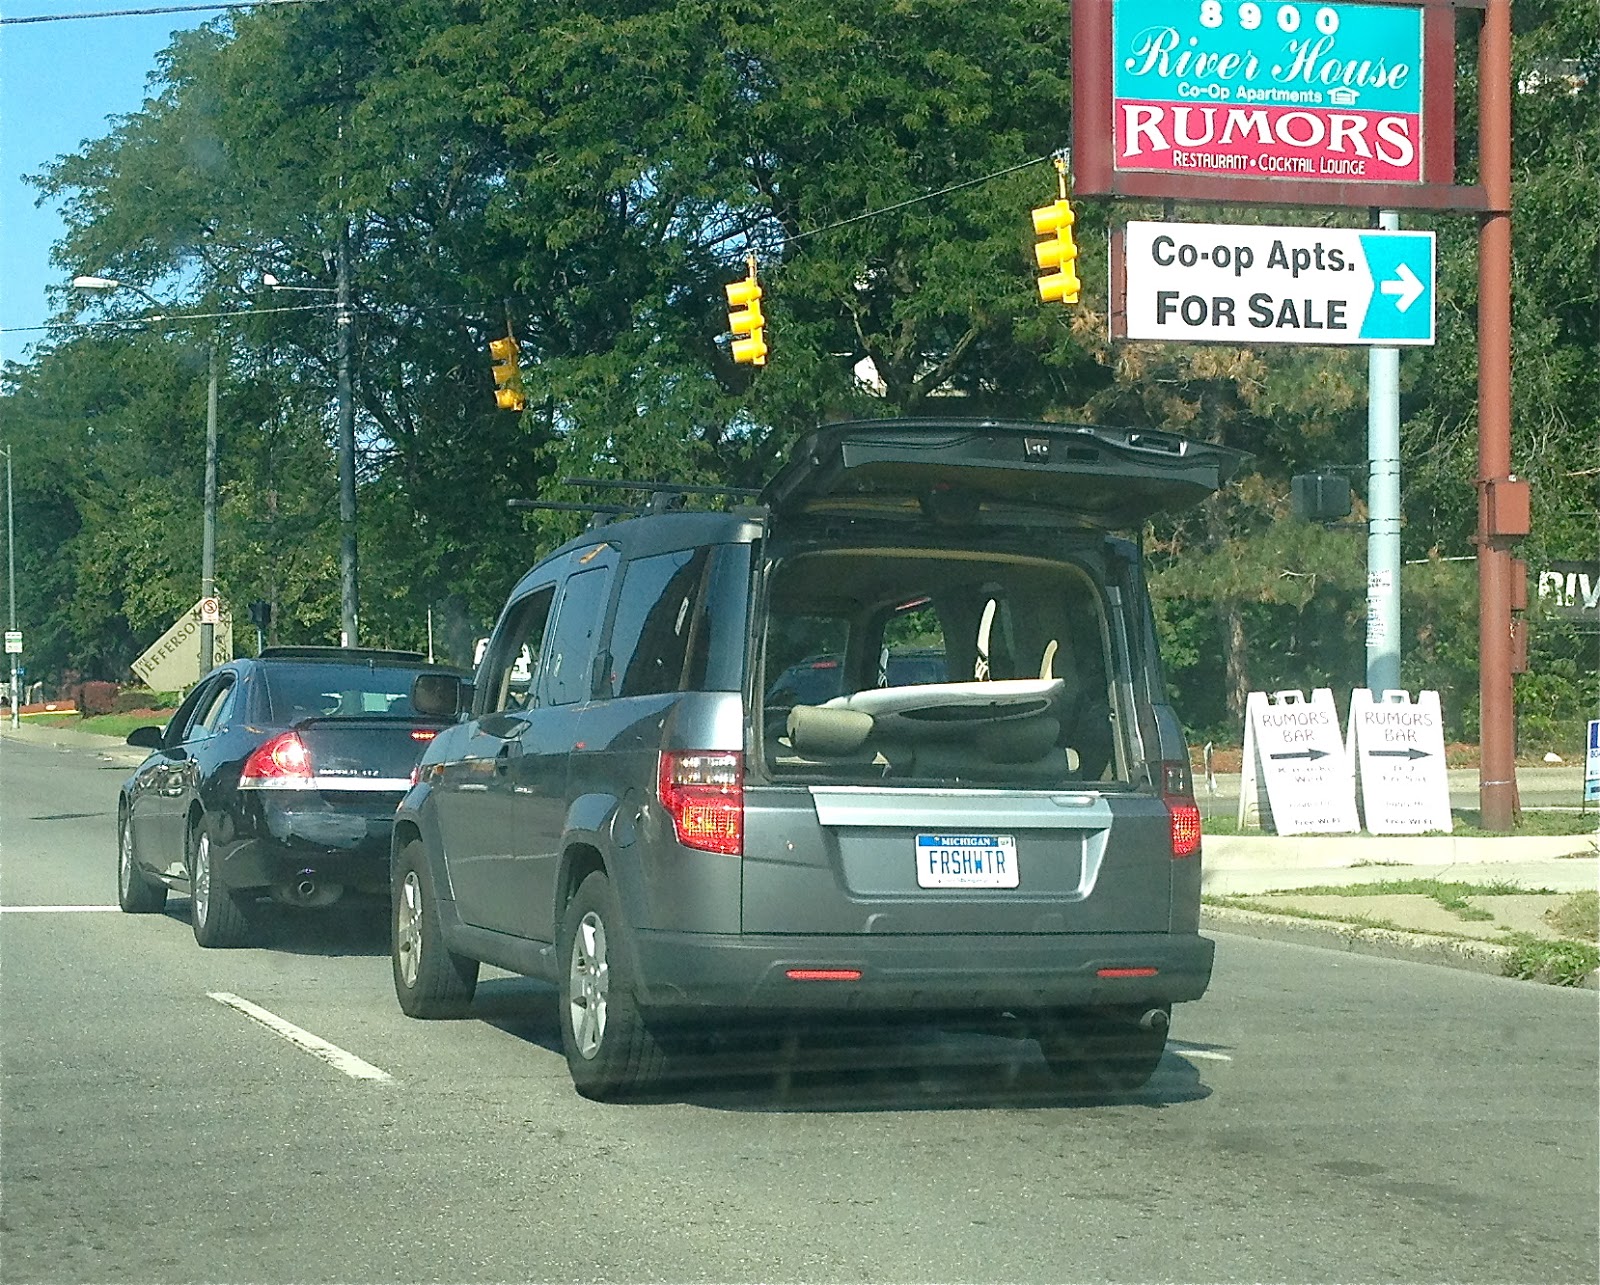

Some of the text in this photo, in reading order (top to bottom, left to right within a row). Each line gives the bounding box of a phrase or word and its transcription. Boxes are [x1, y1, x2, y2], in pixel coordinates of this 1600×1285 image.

[1200, 0, 1340, 35] 8900
[1125, 25, 1410, 89] River House
[1177, 82, 1322, 103] Co-Op Apartments
[1122, 104, 1414, 167] RUMORS
[1173, 150, 1365, 175] RESTAURANT COCKTAIL LOUNGE
[1151, 235, 1354, 278] Co-op Apts.
[1157, 291, 1347, 329] FOR SALE
[1263, 712, 1328, 727] RUMORS
[1365, 712, 1432, 726] RUMORS
[1283, 729, 1315, 742] BAR
[1385, 729, 1417, 742] BAR
[941, 837, 991, 846] MICHIGAN
[929, 850, 1006, 874] FRSHWTR
